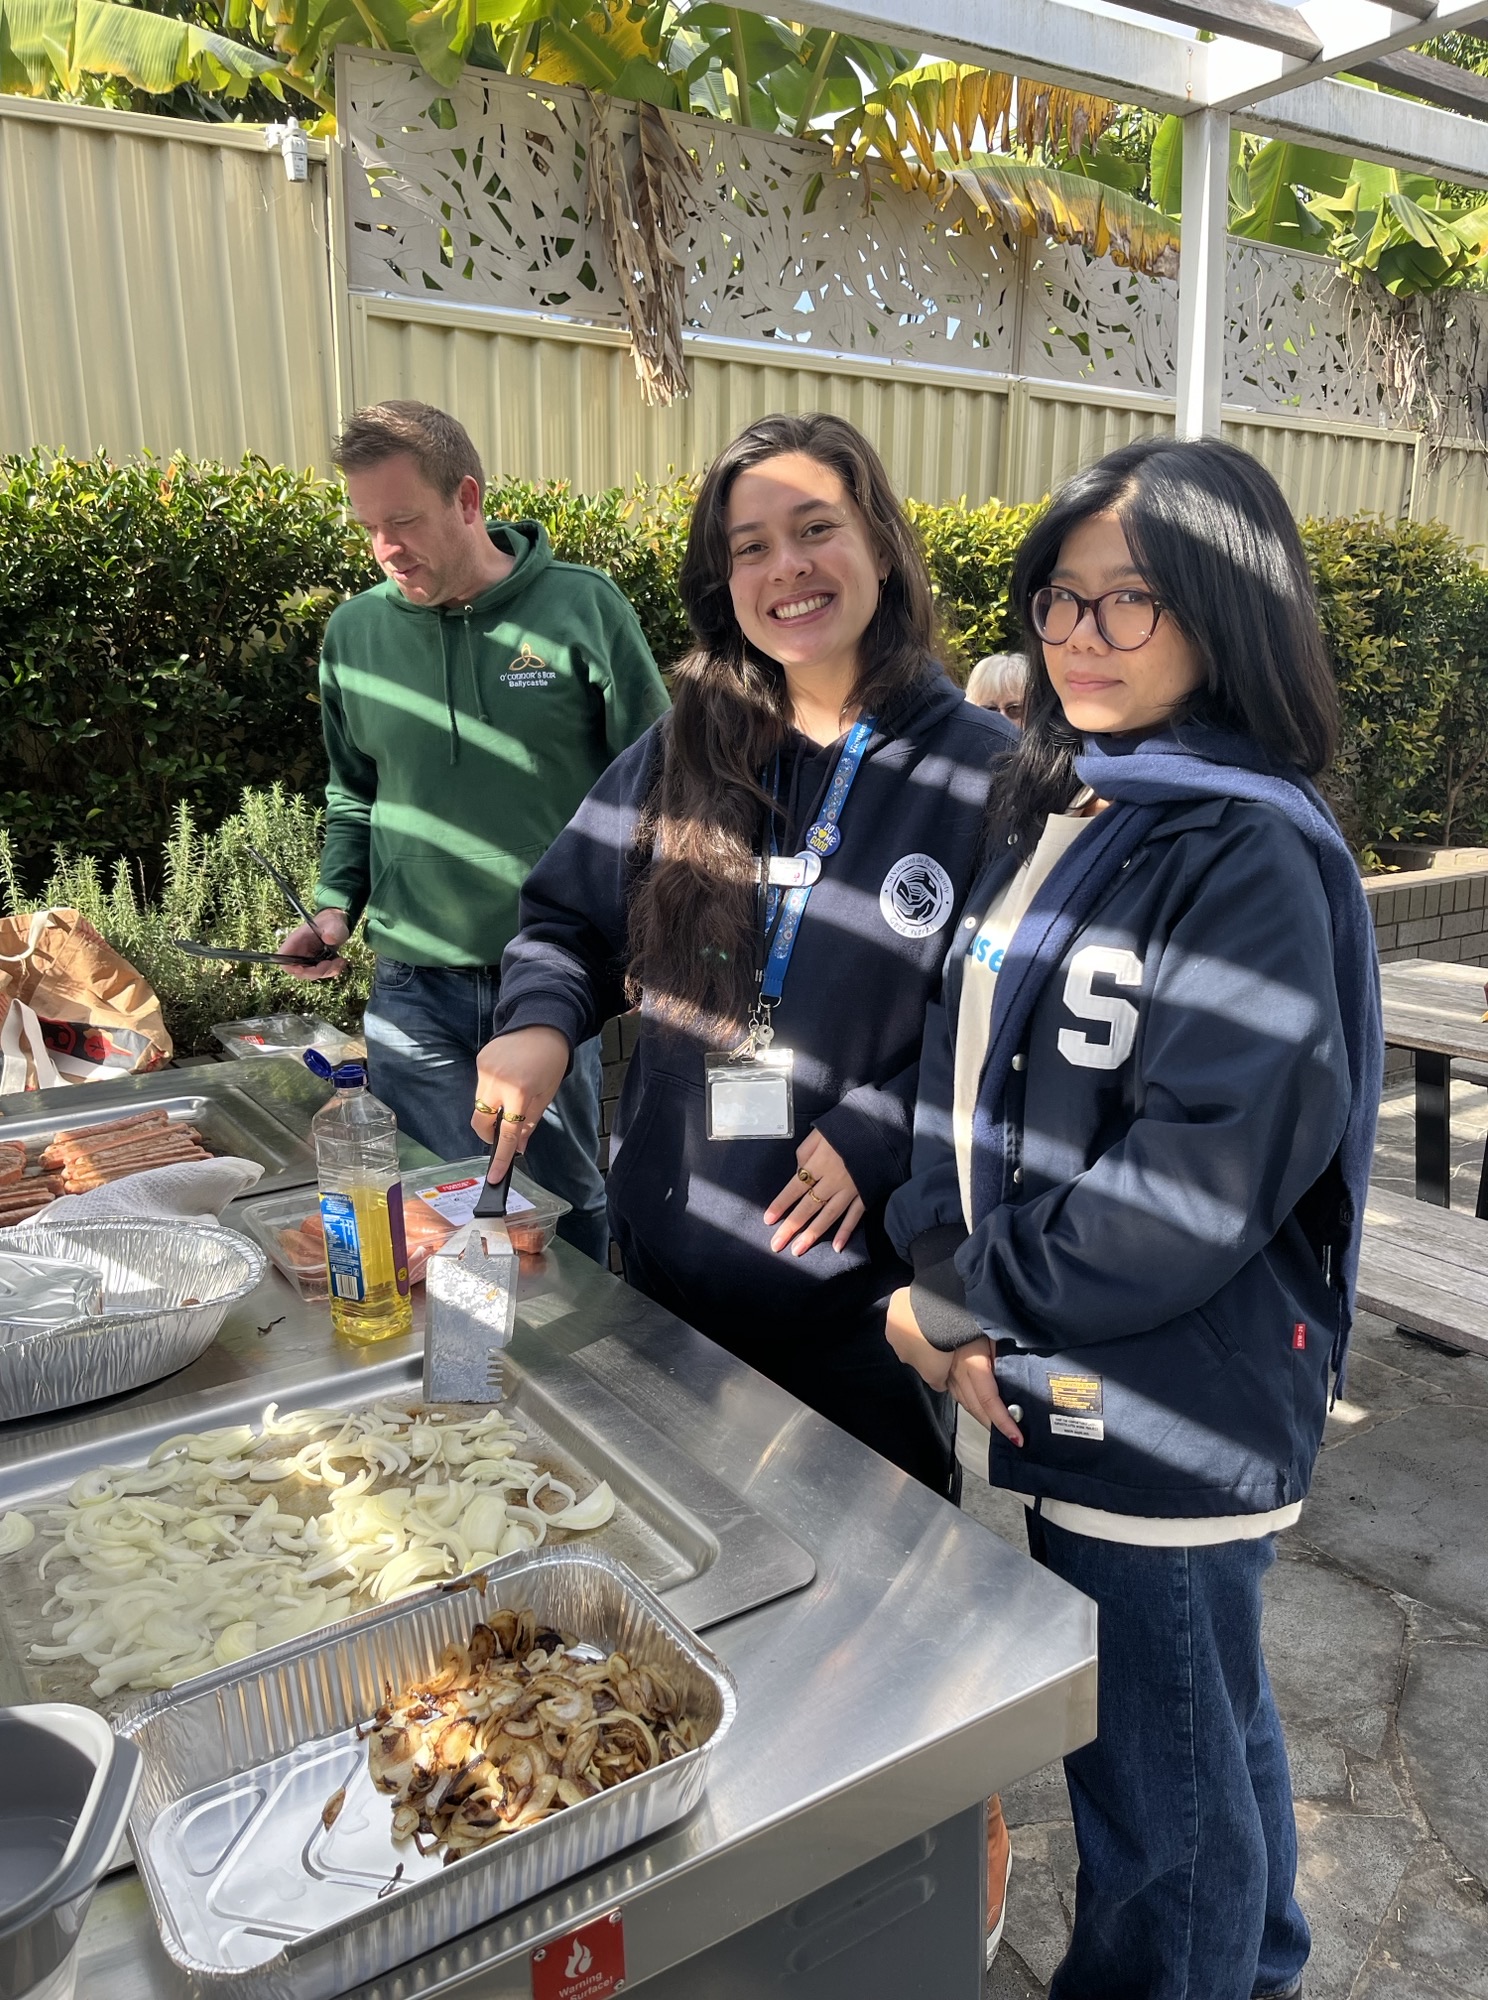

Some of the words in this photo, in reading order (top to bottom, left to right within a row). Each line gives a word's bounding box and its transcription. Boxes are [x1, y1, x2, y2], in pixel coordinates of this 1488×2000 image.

[509, 680, 548, 688] Ballycastle
[824, 822, 835, 834] DO
[810, 835, 829, 852] GOOD
[891, 857, 916, 875] Vincent
[924, 858, 938, 871] Paul
[935, 868, 951, 894] Society
[1058, 945, 1144, 1070] S
[558, 1972, 603, 1998] Warning
